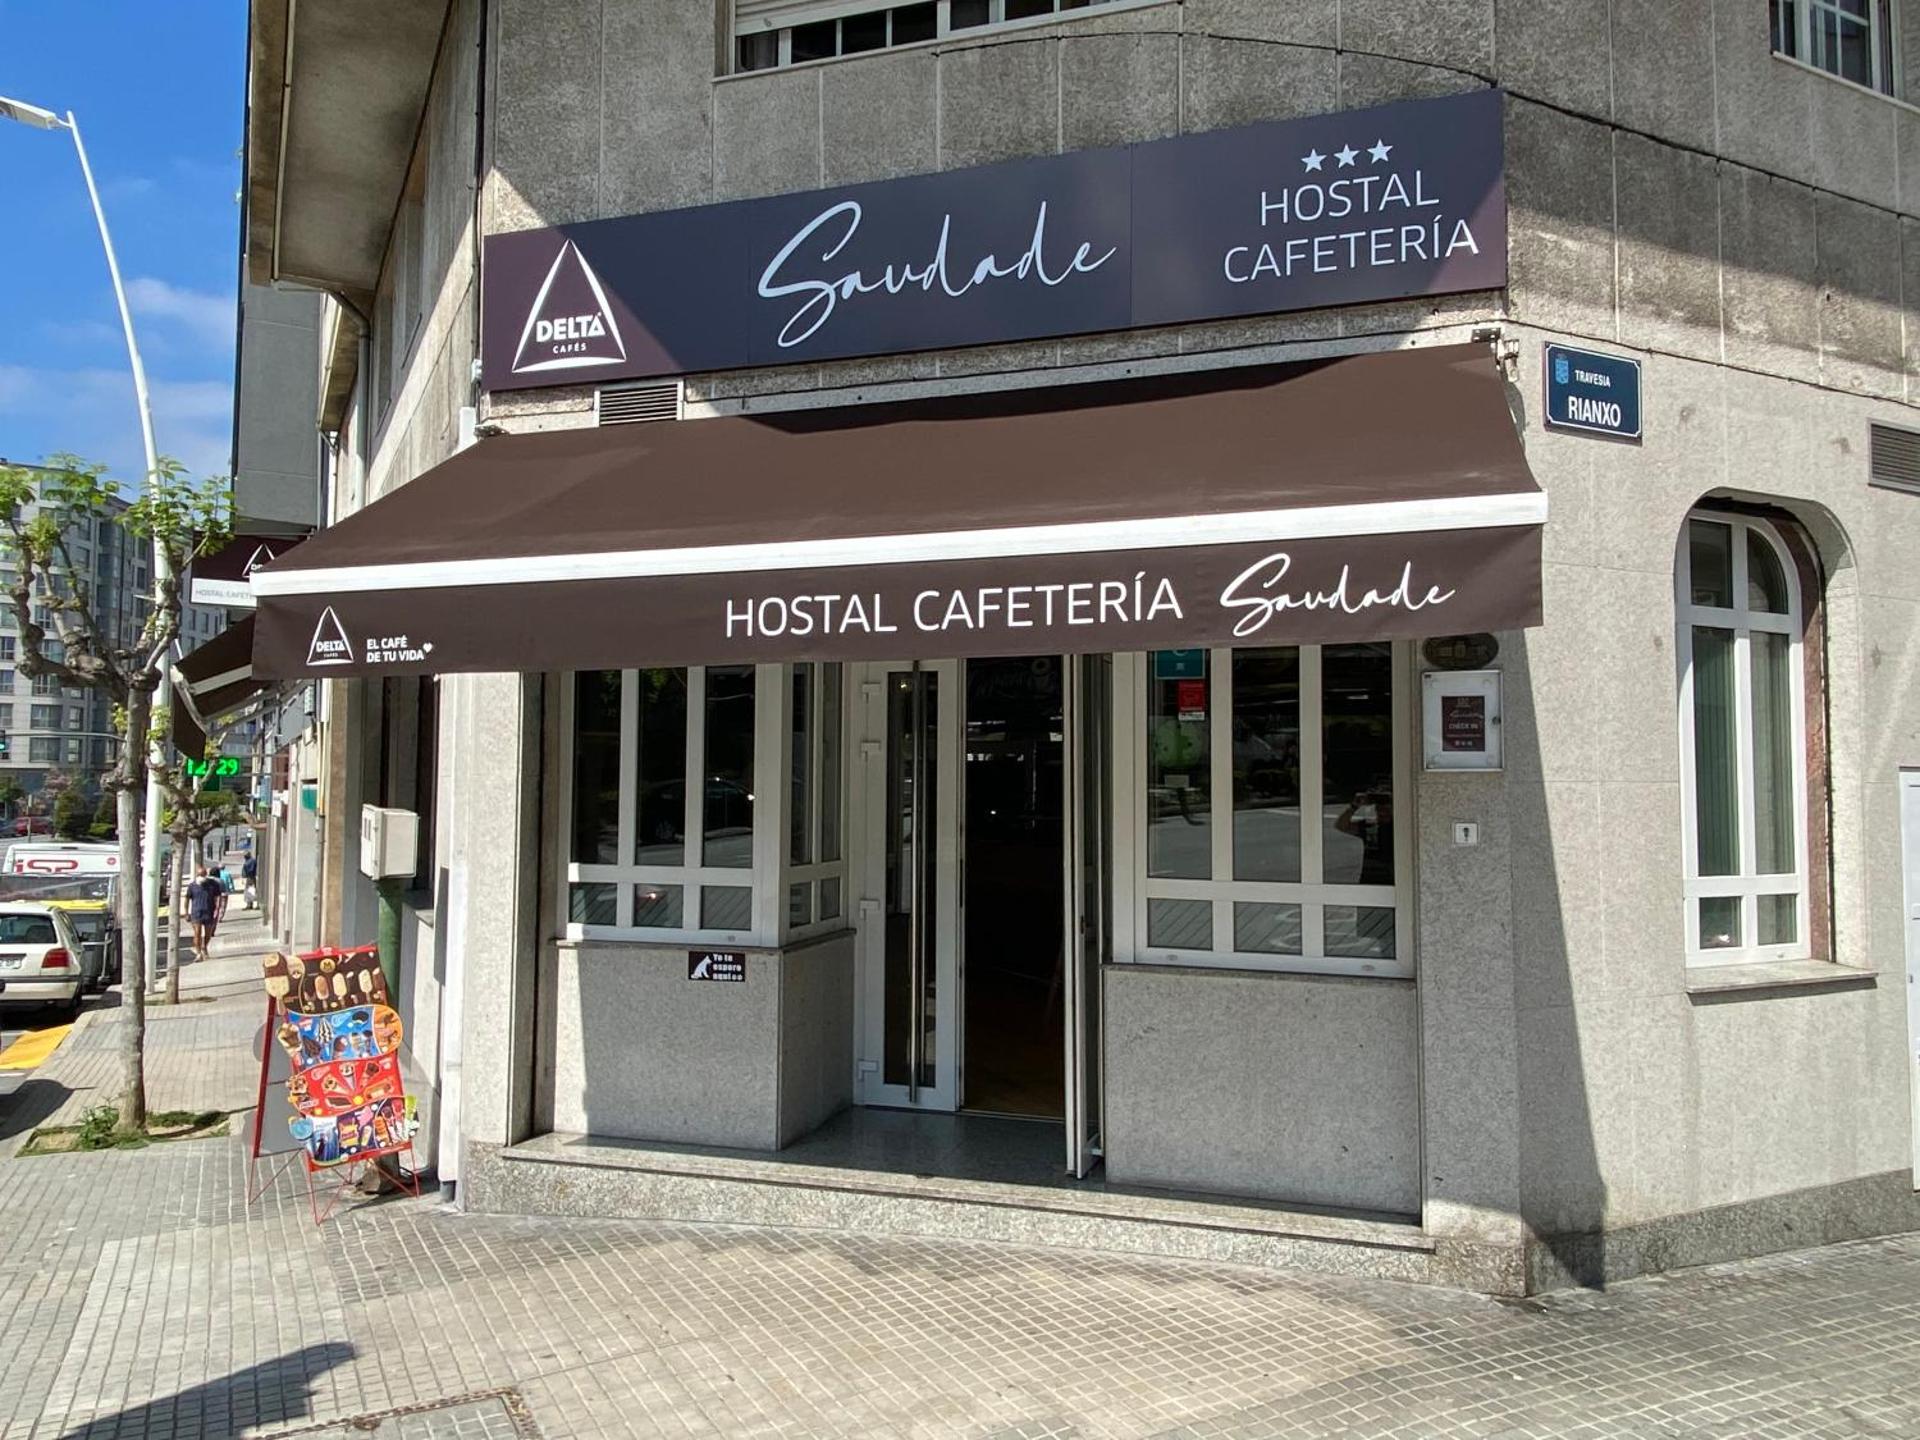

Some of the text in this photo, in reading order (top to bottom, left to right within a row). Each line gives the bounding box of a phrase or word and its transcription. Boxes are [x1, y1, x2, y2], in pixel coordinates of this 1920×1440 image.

[1260, 169, 1440, 227] HOSTAL
[1224, 214, 1480, 283] CAFETERÍA
[757, 200, 1117, 348] Saudade
[536, 312, 606, 342] DELTA
[552, 342, 587, 354] CAFÉS
[1567, 395, 1622, 428] RIANXO
[726, 553, 1456, 638] HOSTAL CAFETERÍA Saudade
[315, 640, 346, 653] DELTA
[366, 634, 408, 650] EL CAFÉ
[366, 649, 425, 663] DE TU VIDA
